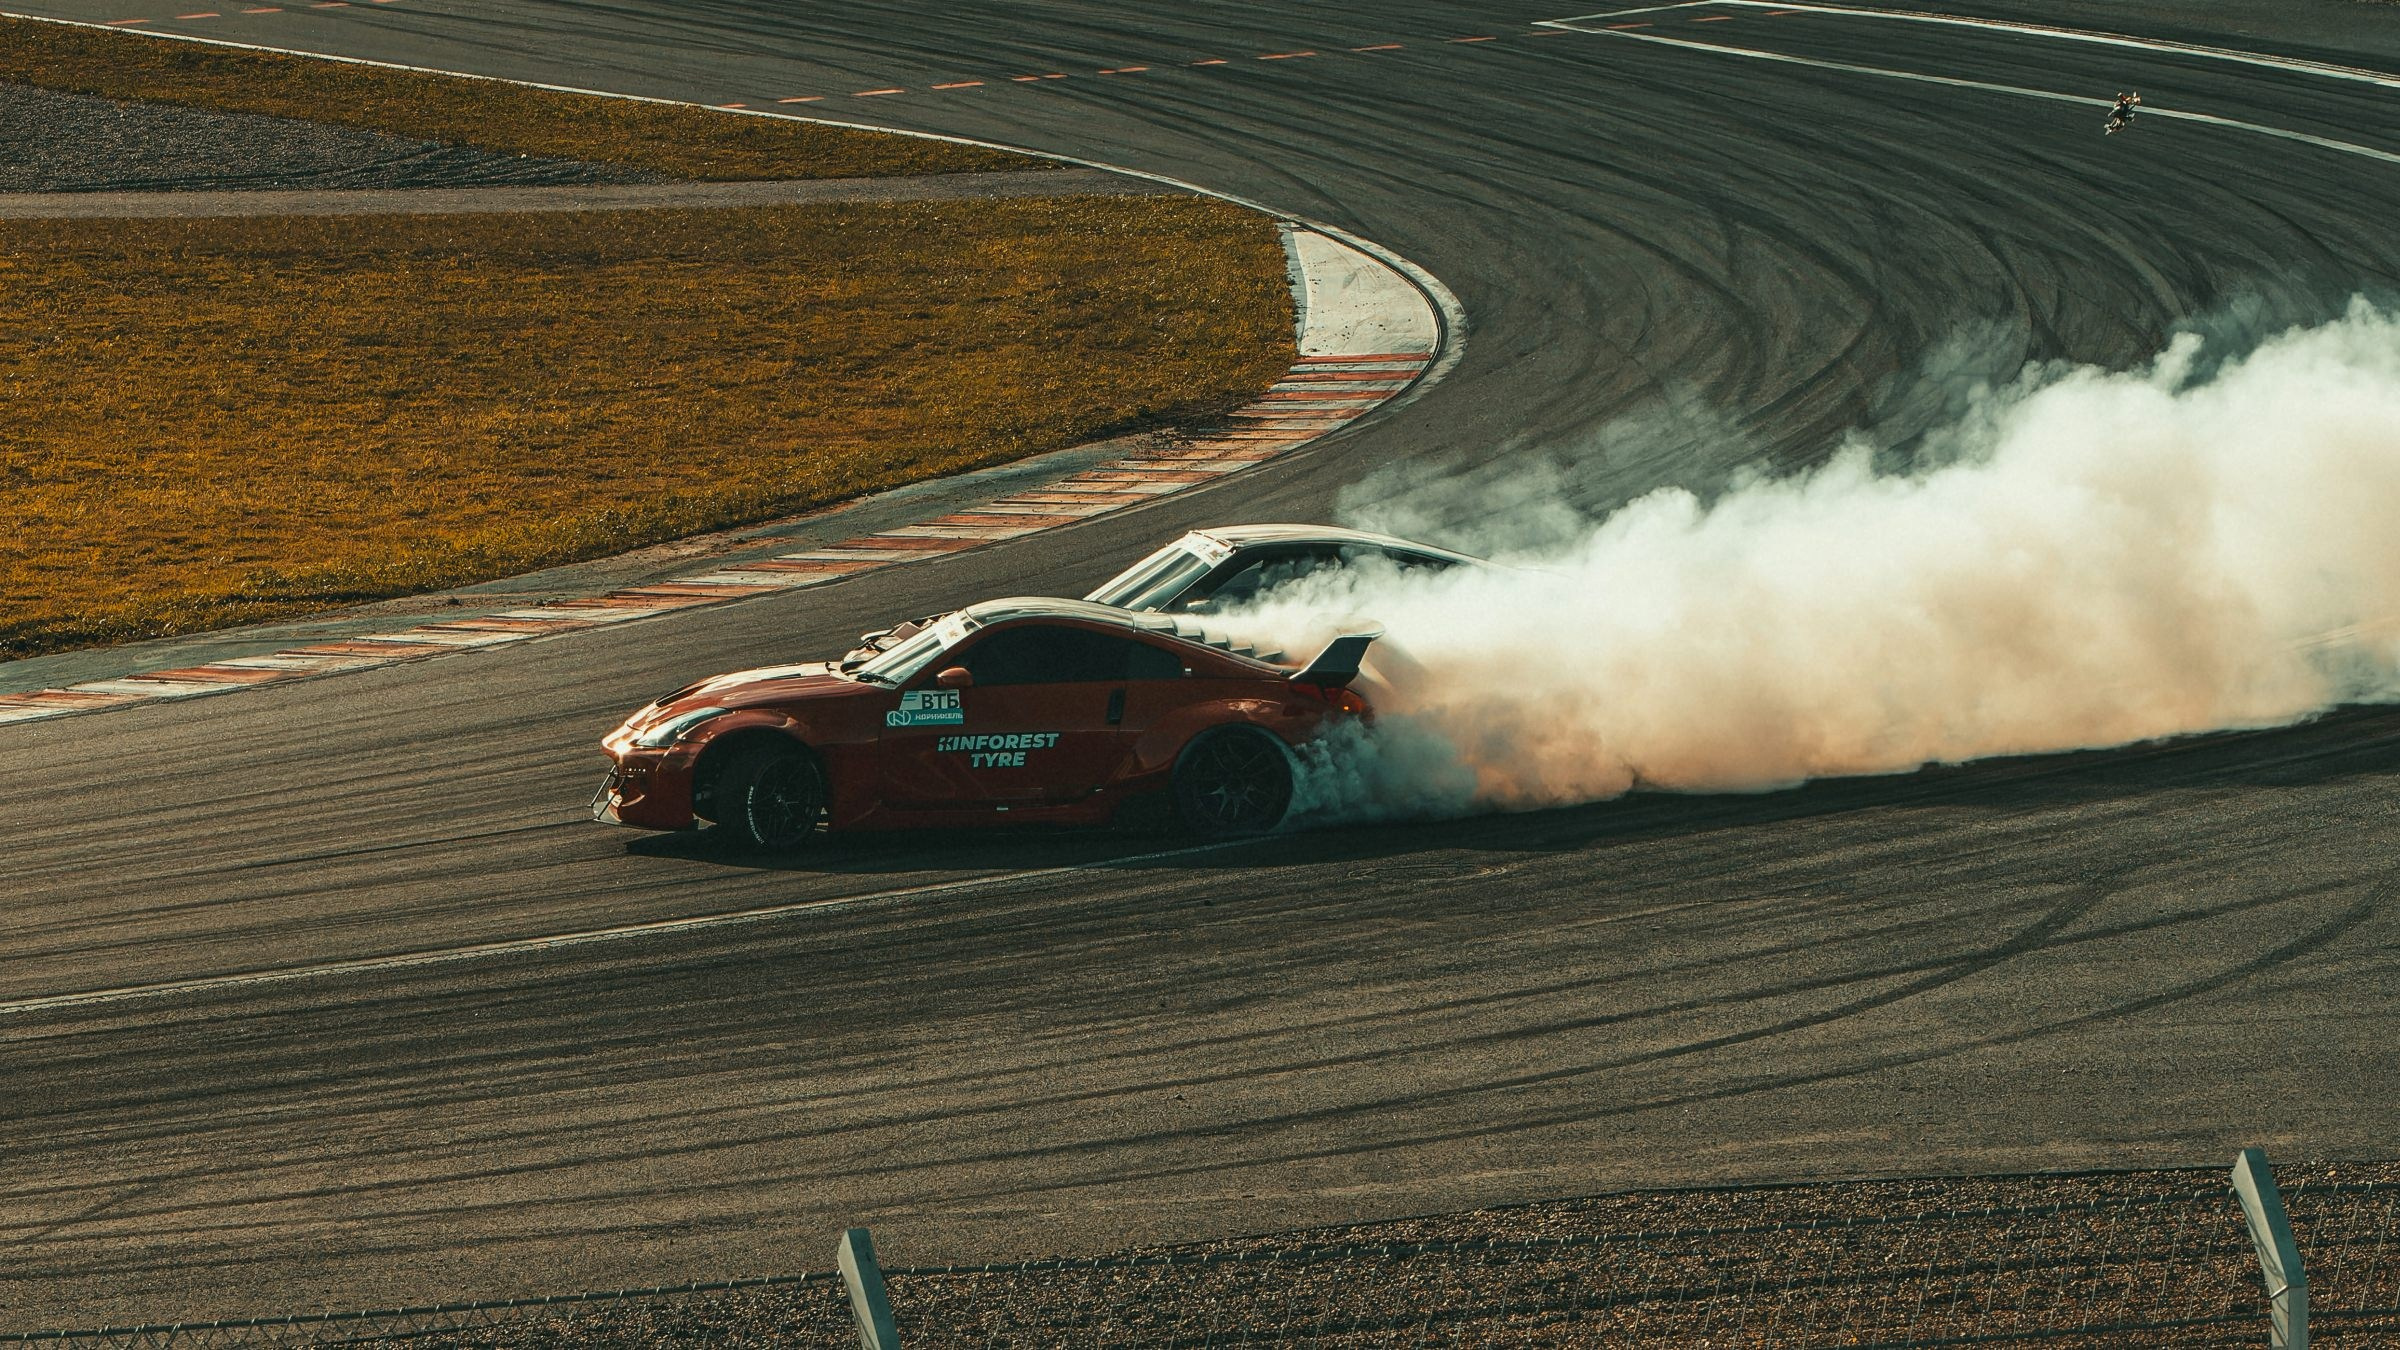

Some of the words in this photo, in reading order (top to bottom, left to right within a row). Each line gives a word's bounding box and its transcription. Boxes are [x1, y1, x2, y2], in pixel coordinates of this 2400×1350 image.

[922, 693, 959, 709] ВТБ
[939, 733, 1059, 751] KINFOREST
[972, 752, 1025, 767] TYRE
